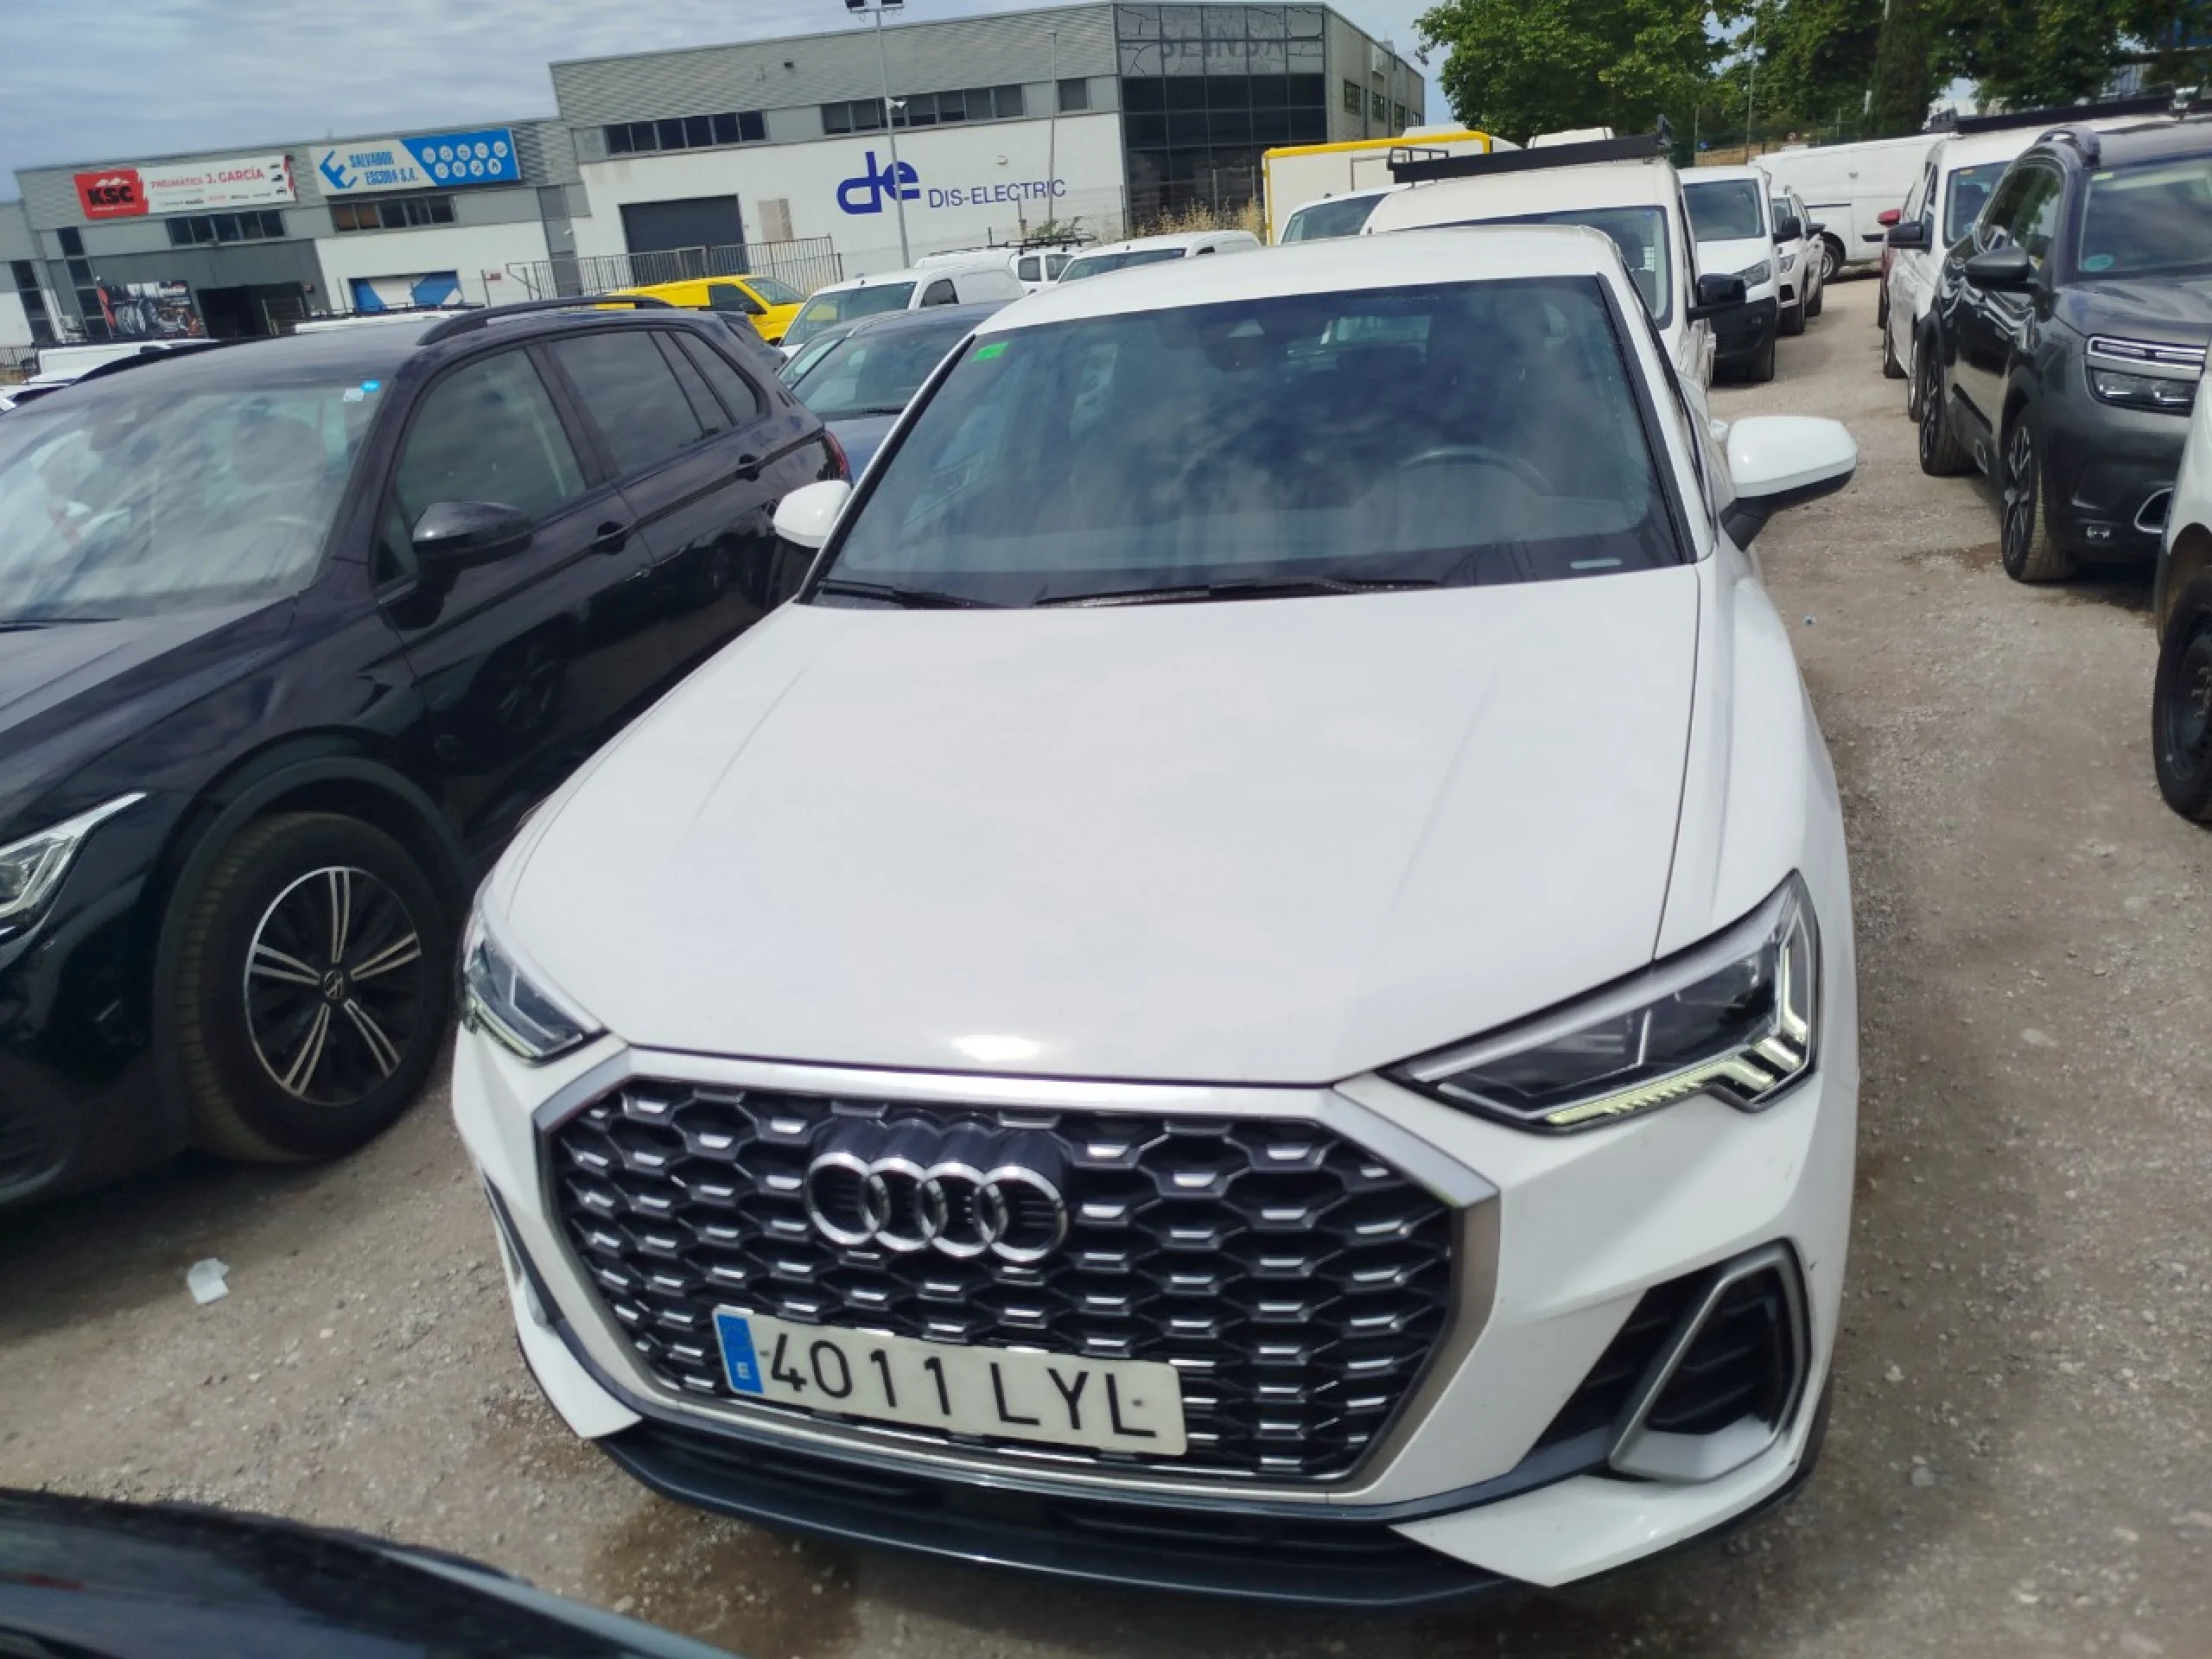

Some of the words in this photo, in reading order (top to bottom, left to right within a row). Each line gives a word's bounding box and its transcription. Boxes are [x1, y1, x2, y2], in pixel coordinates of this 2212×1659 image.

[86, 186, 135, 204] KSC
[928, 179, 1067, 208] DIS-ELECTRIC
[736, 1363, 750, 1380] E
[770, 1333, 950, 1416] 4011
[989, 1361, 1157, 1439] LYL
